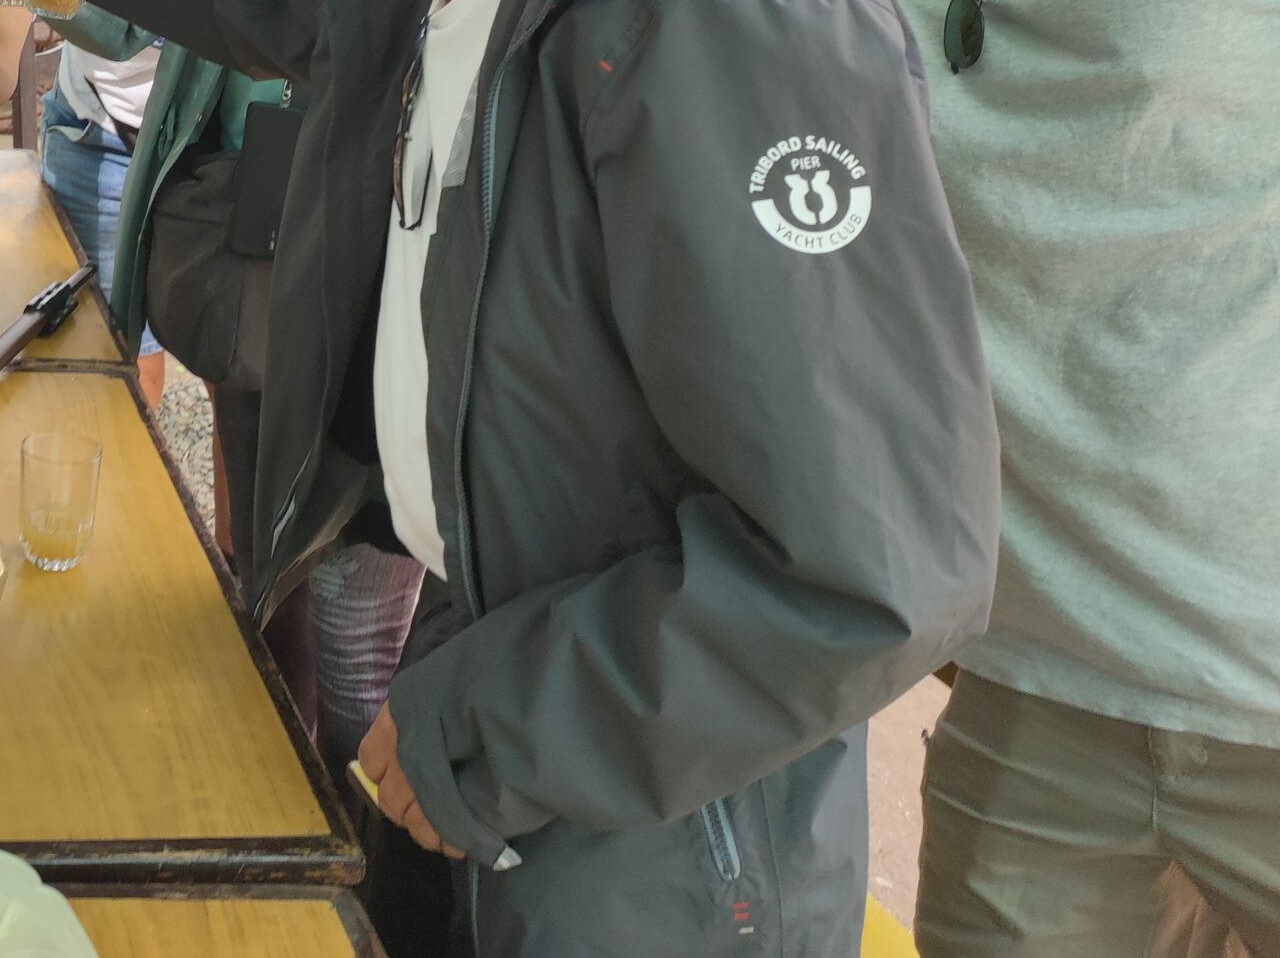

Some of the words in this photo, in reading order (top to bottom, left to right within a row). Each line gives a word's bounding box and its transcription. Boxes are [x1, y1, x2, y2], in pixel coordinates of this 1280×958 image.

[749, 136, 802, 194] TRIBORD
[805, 135, 866, 180] SAILING
[790, 155, 821, 172] PIER
[775, 223, 824, 248] YACHT
[829, 213, 862, 245] CLUB
